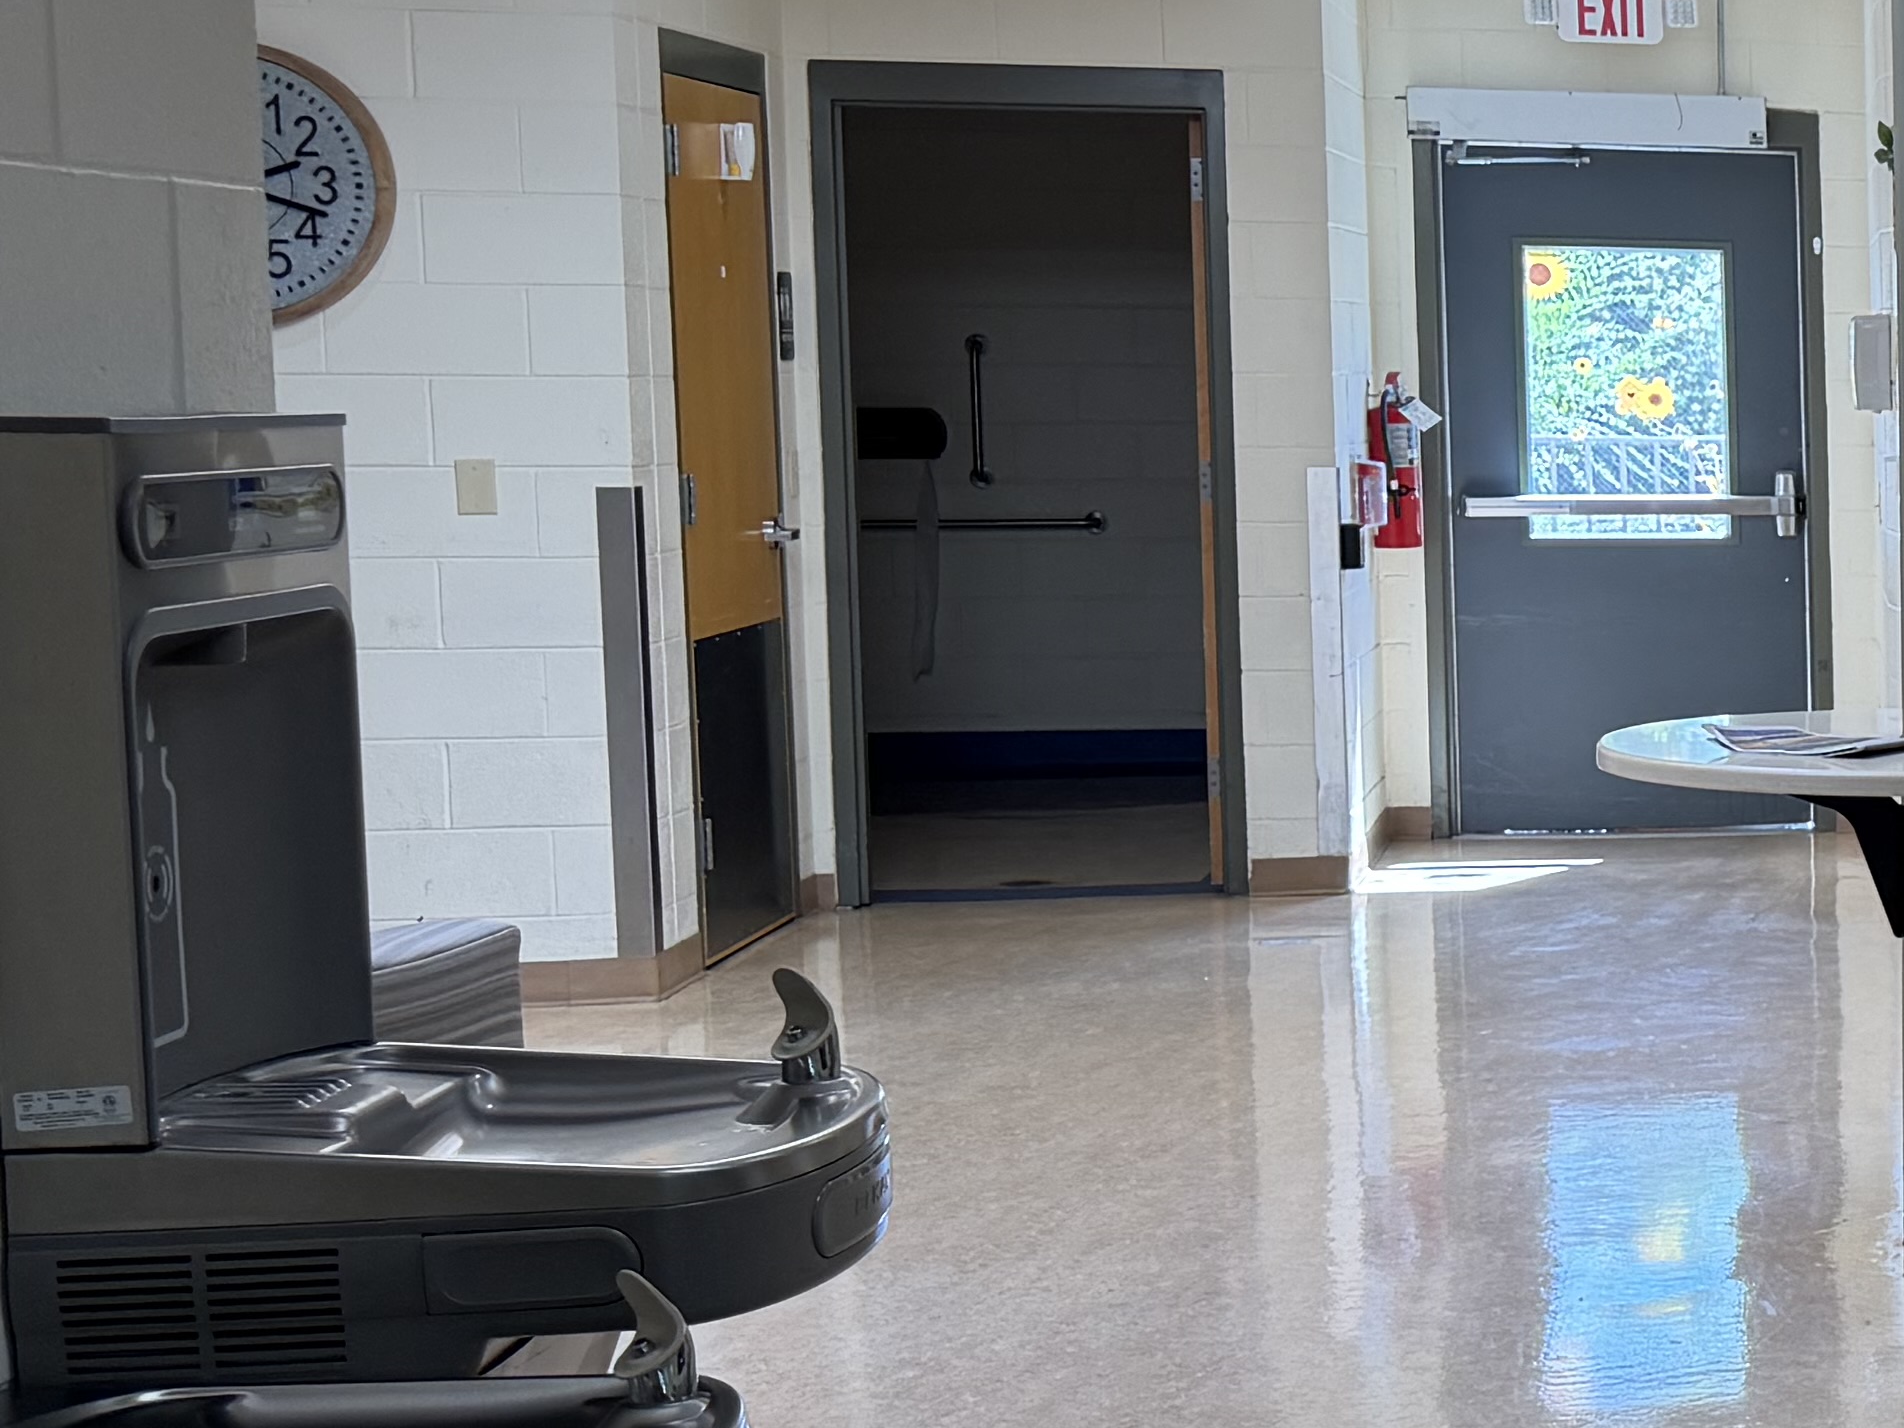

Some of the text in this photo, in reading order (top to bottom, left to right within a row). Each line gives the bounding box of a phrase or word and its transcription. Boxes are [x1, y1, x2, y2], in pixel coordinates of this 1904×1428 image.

[265, 93, 281, 135] 1
[294, 115, 320, 157] 2
[313, 166, 338, 205] 3
[294, 212, 322, 247] 4
[268, 239, 292, 278] 5
